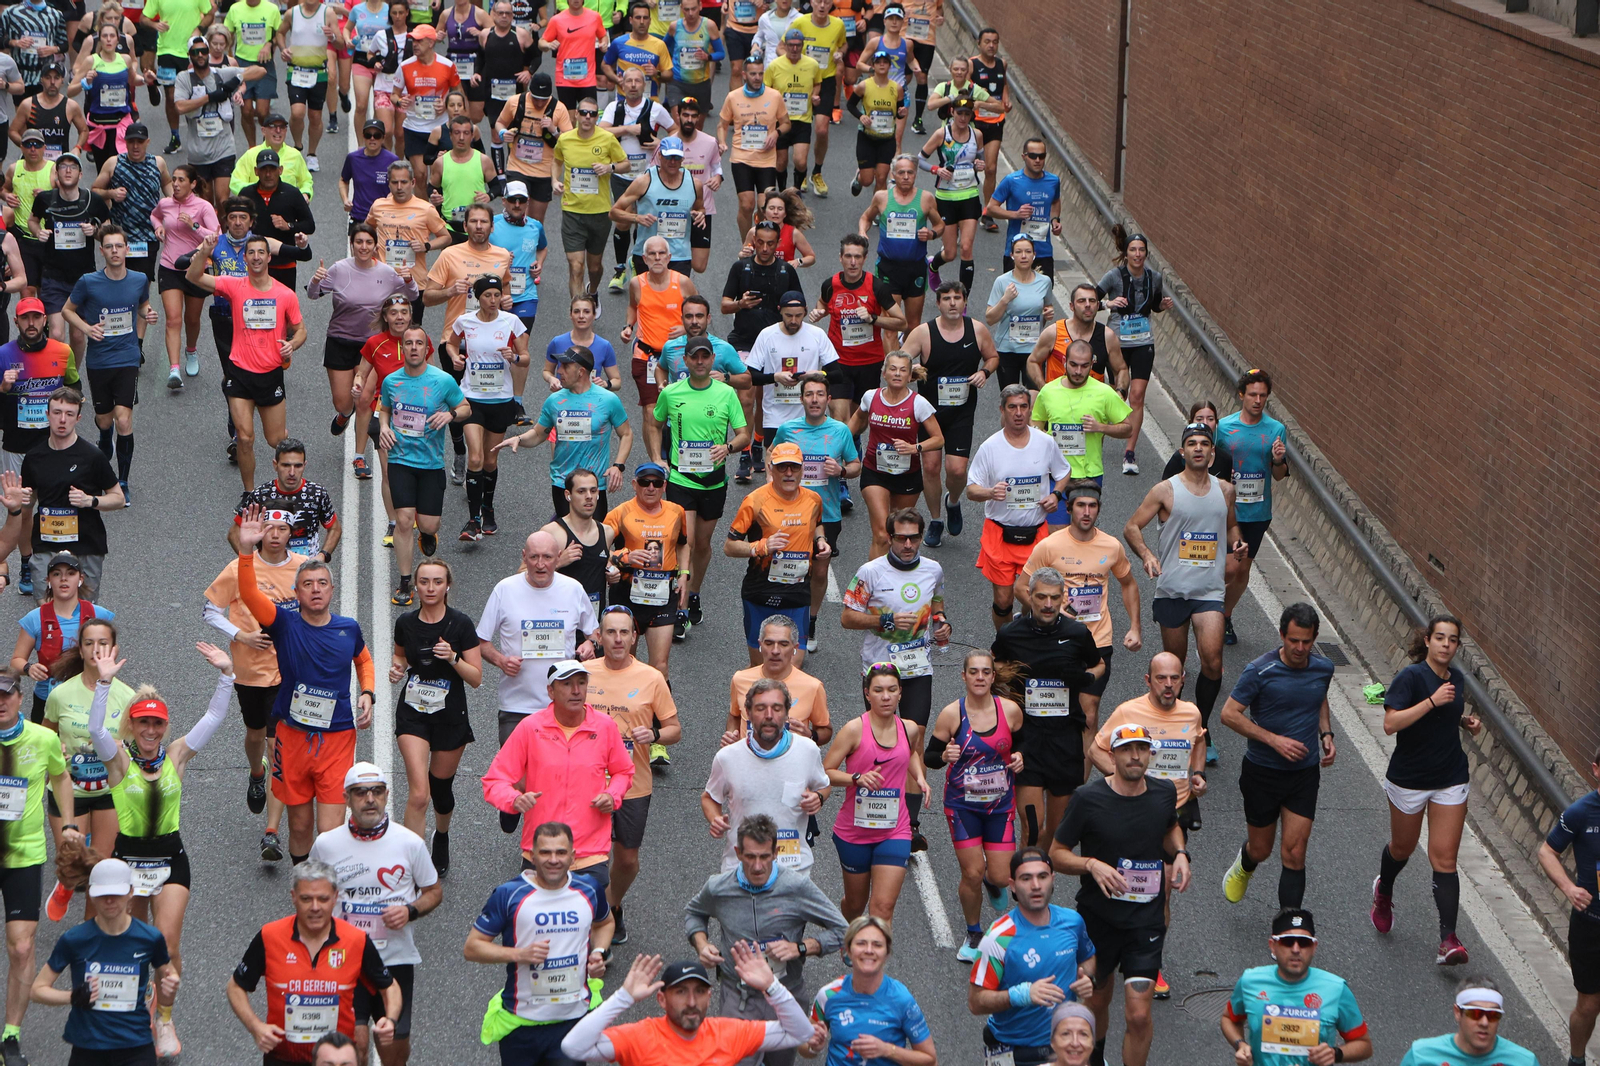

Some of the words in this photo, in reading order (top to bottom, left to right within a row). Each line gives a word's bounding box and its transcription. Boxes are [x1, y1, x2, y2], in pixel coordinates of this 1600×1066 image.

[624, 52, 655, 60] agustinos
[873, 98, 892, 107] teika
[40, 128, 65, 137] TRAIL
[870, 412, 911, 427] Run2Forty2
[900, 641, 922, 650] ZURICH
[422, 678, 446, 688] ZURICH
[308, 688, 334, 698] ZURICH
[417, 689, 436, 698] 10273
[304, 700, 321, 708] 9367
[610, 704, 629, 712] Sevilla
[85, 766, 105, 774] 11750
[979, 764, 1001, 774] ZURICH
[0, 778, 23, 787] URICH
[336, 863, 364, 874] CIRCUITO
[358, 886, 382, 896] SATO
[355, 905, 383, 914] ZURICH
[534, 910, 580, 926] OTIS
[354, 920, 372, 928] 7474
[546, 926, 580, 934] ASCENSOR!
[546, 957, 575, 968] ZURICH
[103, 964, 134, 974] ZURICH
[548, 974, 566, 984] 9972
[100, 980, 123, 989] 10374
[289, 980, 302, 992] CA
[304, 980, 338, 993] GERENA
[302, 997, 334, 1005] ZURICH
[301, 1012, 321, 1020] 8398
[1282, 1007, 1314, 1018] ZURICH
[292, 1024, 312, 1032] Miguel
[313, 1023, 330, 1032] Ángel
[1281, 1023, 1301, 1033] 3932
[1280, 1036, 1301, 1044] MANEL
